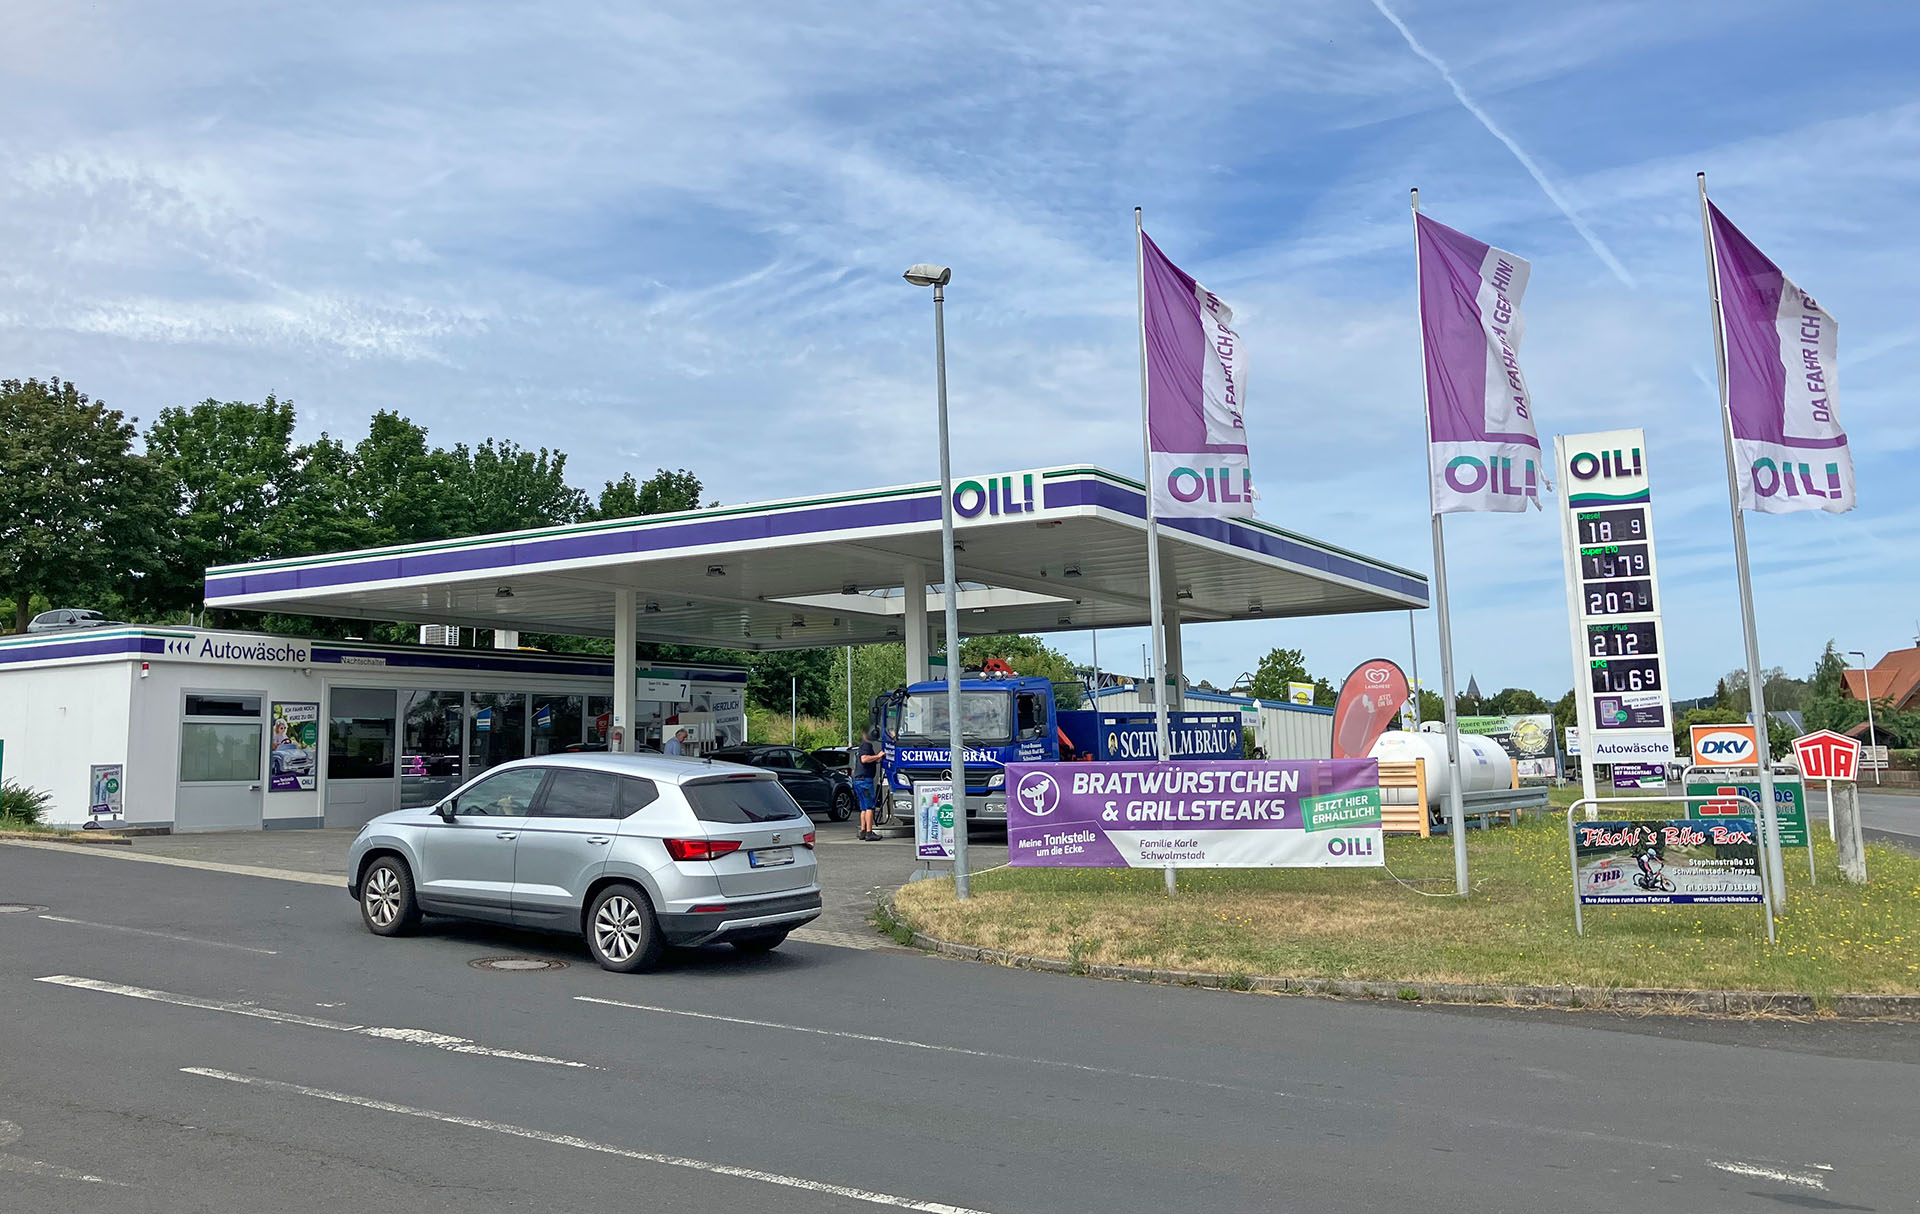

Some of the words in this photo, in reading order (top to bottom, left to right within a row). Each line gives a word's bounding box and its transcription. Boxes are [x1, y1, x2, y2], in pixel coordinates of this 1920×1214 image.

[1491, 258, 1514, 293] HIN!
[1800, 316, 1821, 345] ICH
[1217, 336, 1234, 363] ICH
[1802, 348, 1827, 398] FAHR
[1516, 396, 1529, 420] DA
[1813, 399, 1830, 422] DA
[1570, 448, 1642, 480] OIL!
[1445, 455, 1537, 496] OIL!
[1752, 457, 1842, 499] OIL!
[952, 473, 1034, 519] OIL!
[1578, 511, 1601, 520] Diesel
[1581, 547, 1604, 556] Super
[1605, 545, 1618, 554] E10
[1589, 624, 1611, 632] Super
[1612, 623, 1628, 631] Plus
[200, 638, 307, 663] Autowäsche
[1591, 660, 1608, 669] LPG
[680, 684, 687, 698] 7
[713, 700, 739, 712] HERZLICH
[1195, 724, 1228, 754] BRÄU
[1460, 725, 1511, 735] ffnungszeiten:
[963, 748, 998, 762] BRÄU
[1596, 743, 1669, 754] Autowäsche
[1701, 740, 1749, 754] DKV
[1799, 735, 1855, 777] UTA
[1072, 766, 1299, 795] BRATWÜRSTCHEN
[1737, 786, 1795, 803] Dabe
[1102, 801, 1119, 822] &
[1126, 799, 1286, 822] GRILLSTEAKS
[1313, 799, 1343, 813] JETZT
[1344, 795, 1369, 810] HIER
[1312, 807, 1375, 825] ERHÄLTLICH!
[1018, 839, 1042, 849] Meine
[1043, 830, 1096, 847] Tankstelle
[1140, 838, 1173, 848] Familie
[1174, 838, 1198, 848] Karle
[1661, 826, 1706, 845] Bike
[1709, 826, 1752, 845] Box
[1036, 847, 1050, 857] um
[1051, 845, 1063, 856] die
[1064, 844, 1085, 855] Ecke.
[1140, 850, 1206, 861] Schwalmstadt
[1328, 837, 1373, 856] OIL!
[1744, 857, 1754, 866] 10
[1593, 868, 1621, 884] FBB
[1597, 896, 1620, 904] Adresse
